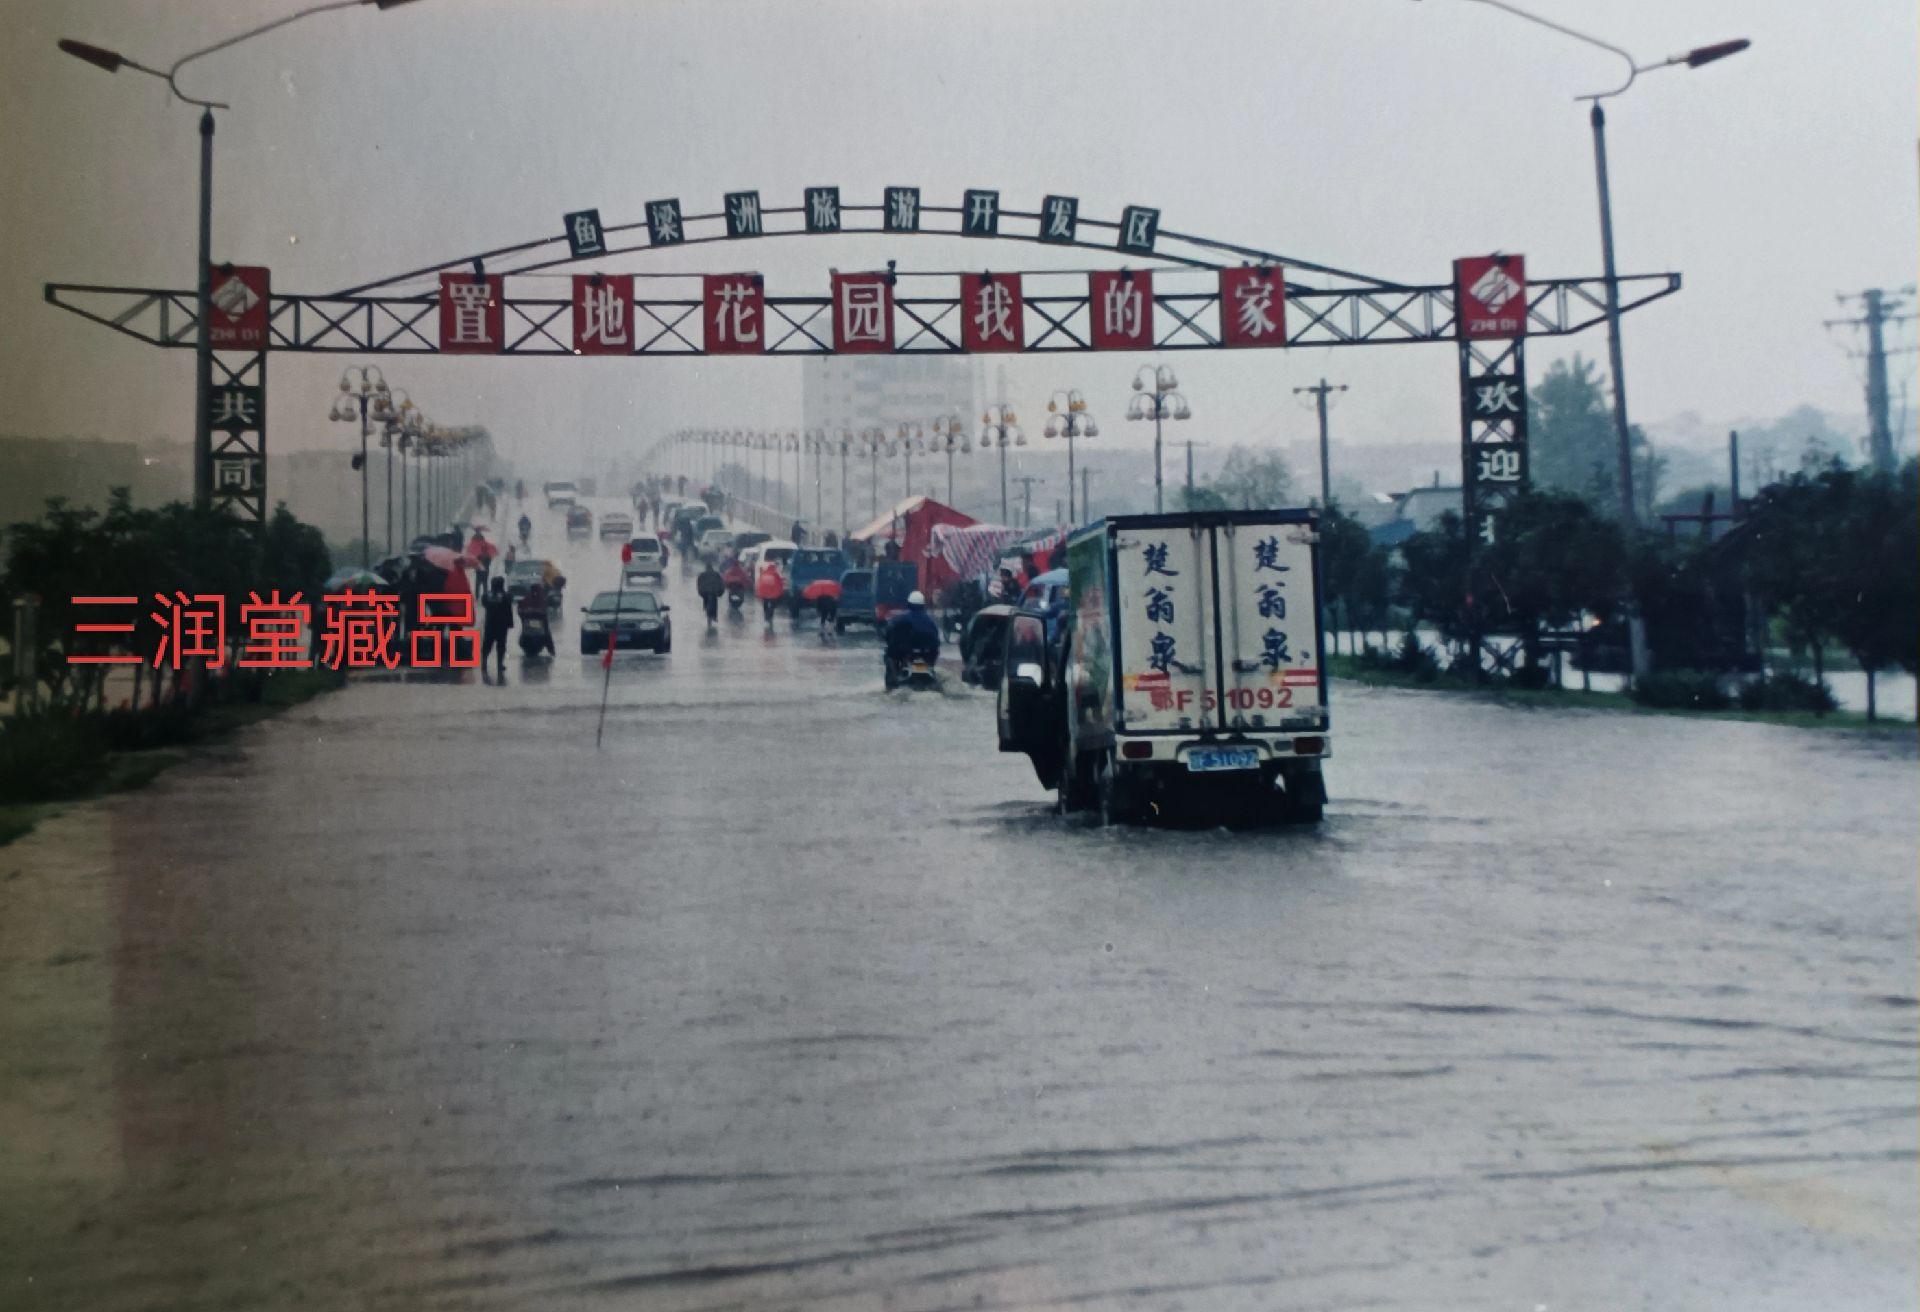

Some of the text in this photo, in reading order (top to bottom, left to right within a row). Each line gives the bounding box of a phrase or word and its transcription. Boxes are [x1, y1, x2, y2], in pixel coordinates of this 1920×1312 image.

[572, 190, 1154, 252] 鱼梁洲旅游开发区
[446, 275, 1275, 347] 置地花园我的家
[1143, 541, 1179, 673] 楚翁泉
[1252, 535, 1292, 670] 楚翁泉
